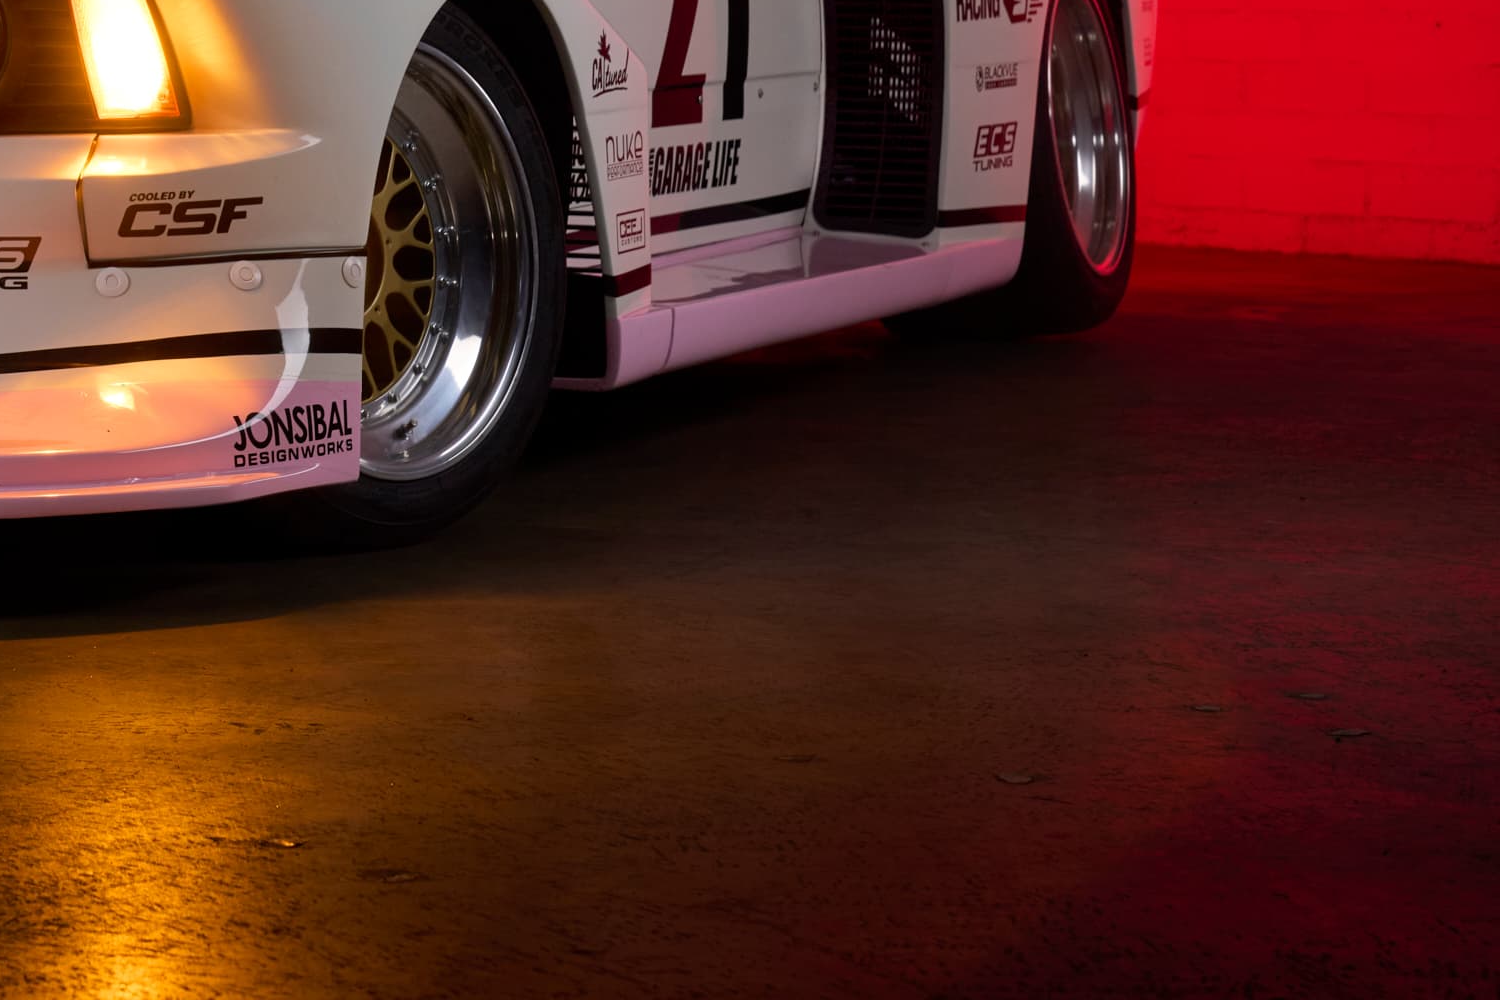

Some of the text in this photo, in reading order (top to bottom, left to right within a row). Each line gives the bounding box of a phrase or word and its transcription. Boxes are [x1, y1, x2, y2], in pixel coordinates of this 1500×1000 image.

[605, 130, 643, 164] nuke
[973, 121, 1018, 158] ECS
[652, 142, 712, 197] GARAGE
[710, 138, 741, 188] LIFE
[972, 156, 1013, 172] TUNING
[129, 190, 196, 202] COOLED BY
[118, 196, 263, 238] CSF
[234, 439, 353, 468] DESIGNWORKS
